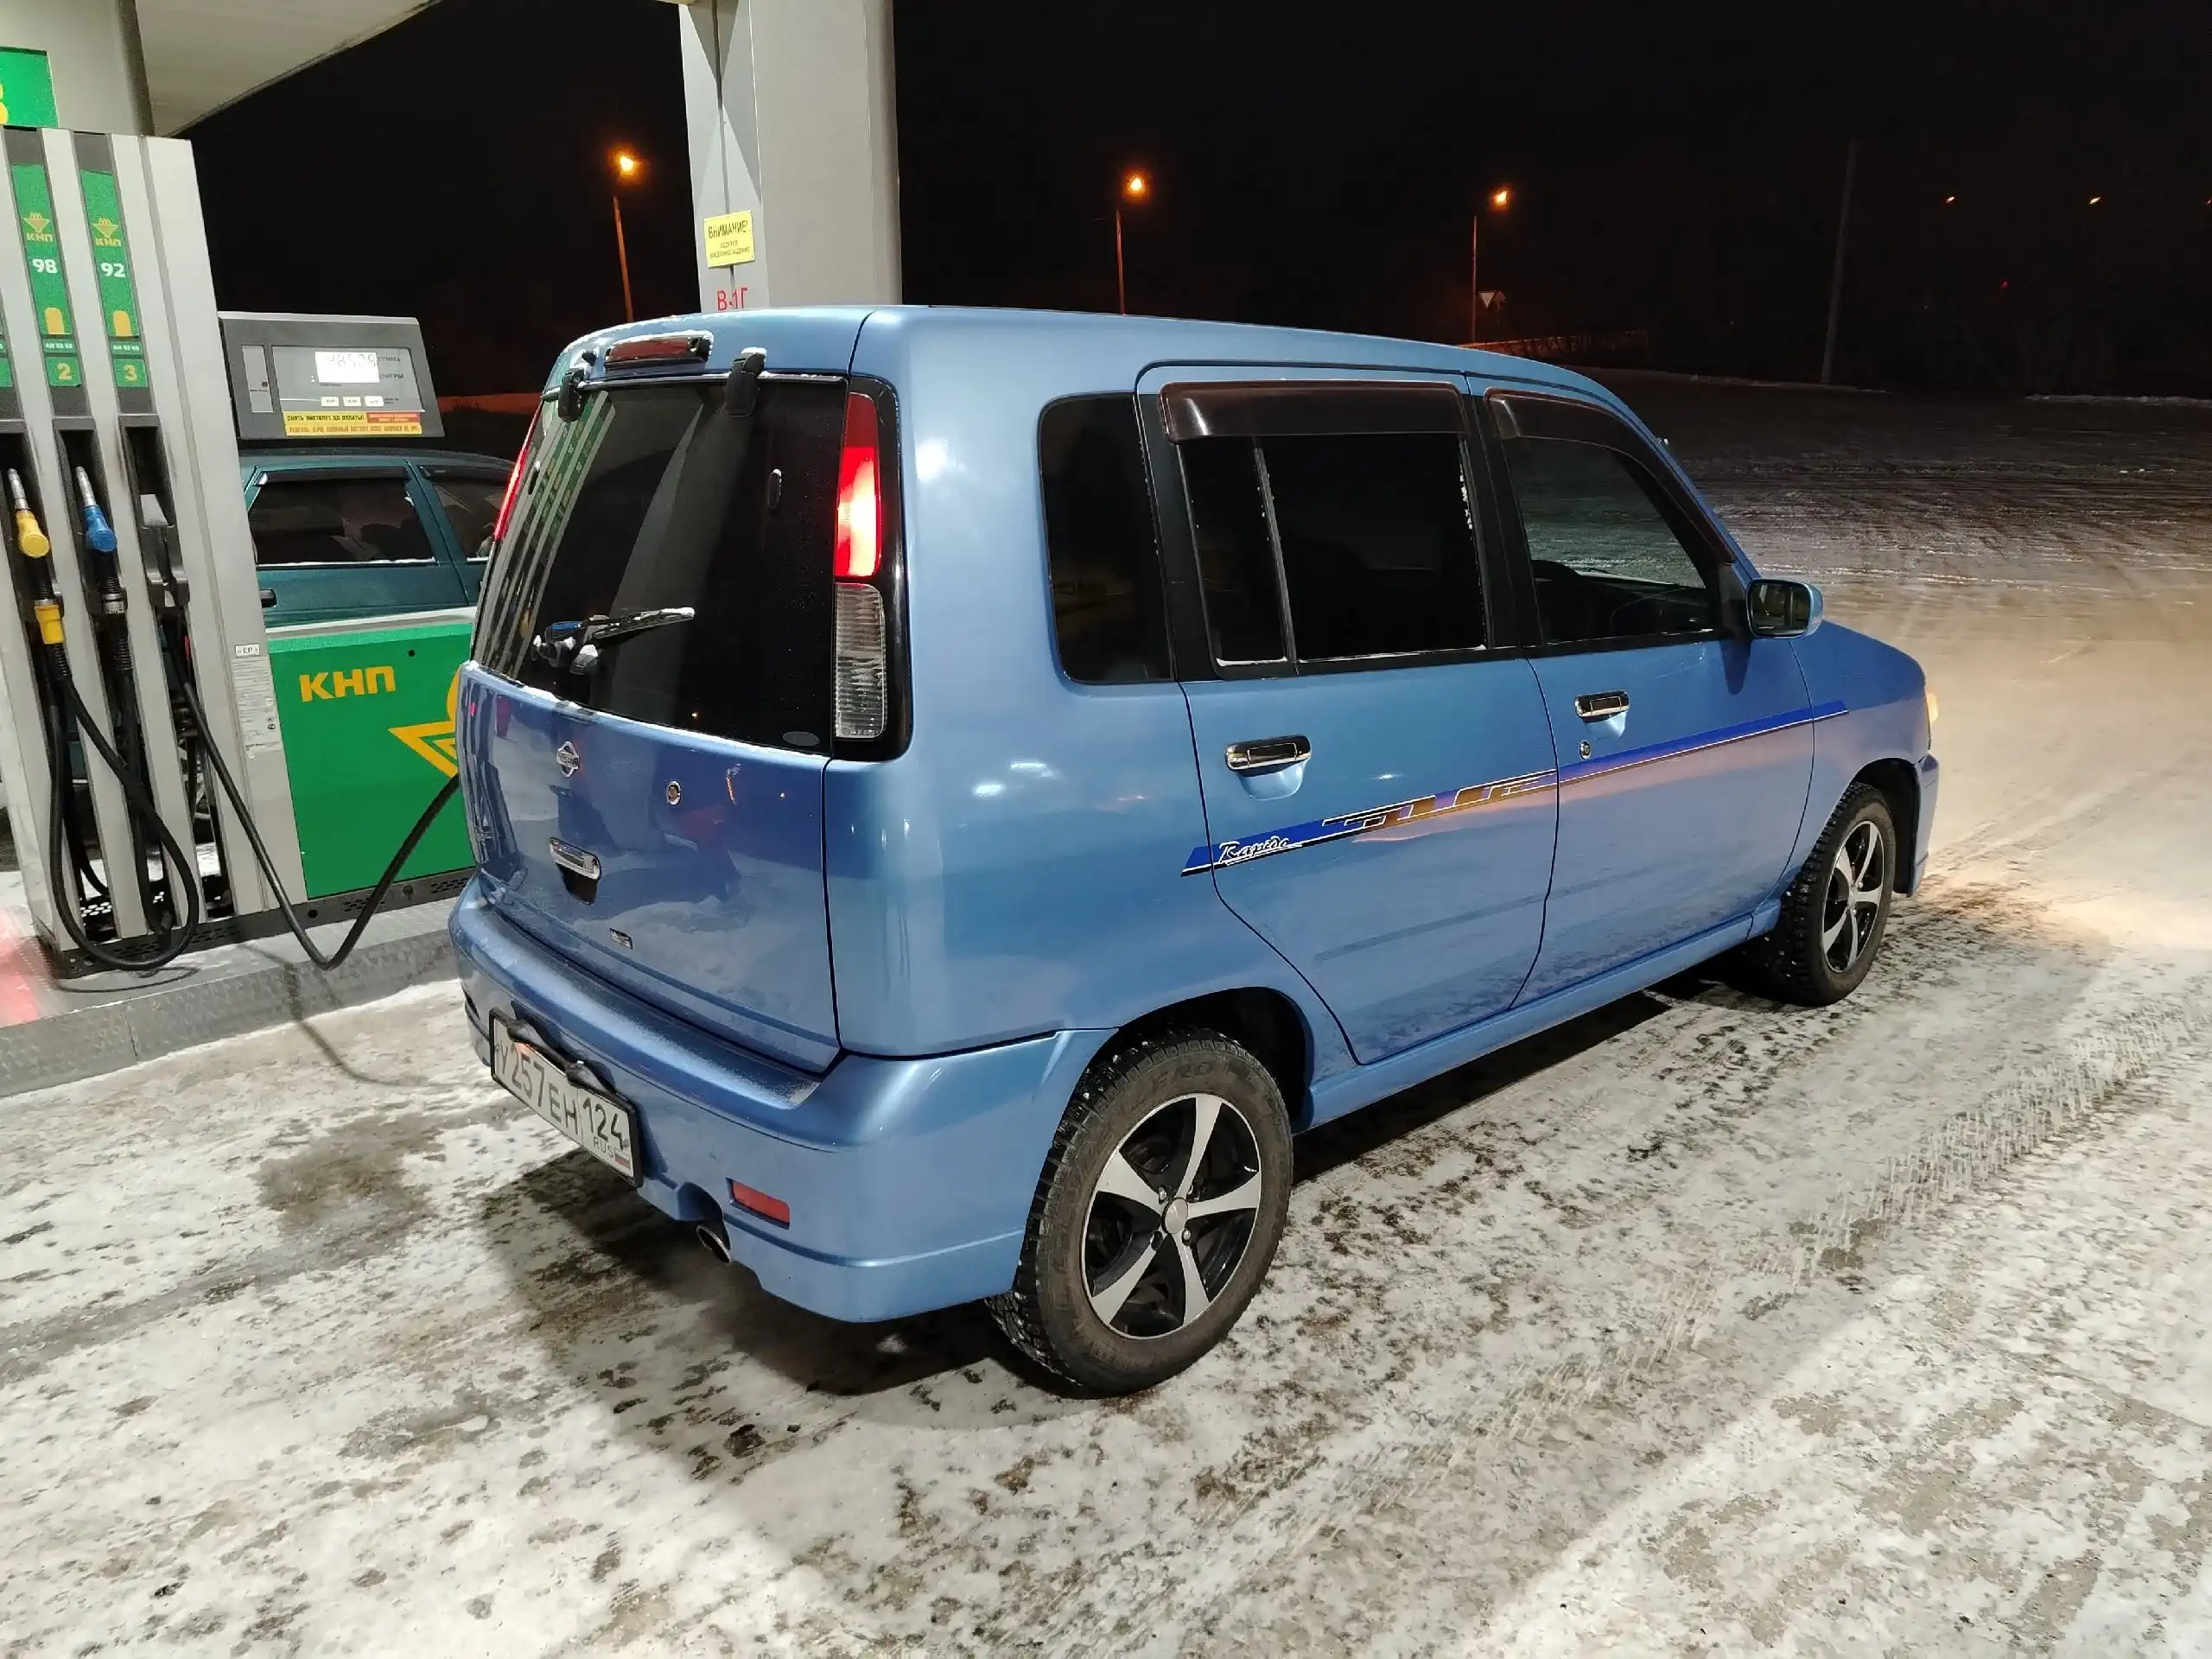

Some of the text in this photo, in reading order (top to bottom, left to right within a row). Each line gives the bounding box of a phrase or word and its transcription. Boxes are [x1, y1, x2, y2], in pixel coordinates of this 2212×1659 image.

[32, 258, 58, 274] 98
[101, 263, 126, 278] 92
[57, 363, 73, 380] 2
[124, 364, 138, 381] 3
[299, 665, 397, 702] КНП
[582, 1096, 625, 1151] 124
[593, 1135, 616, 1159] RUS
